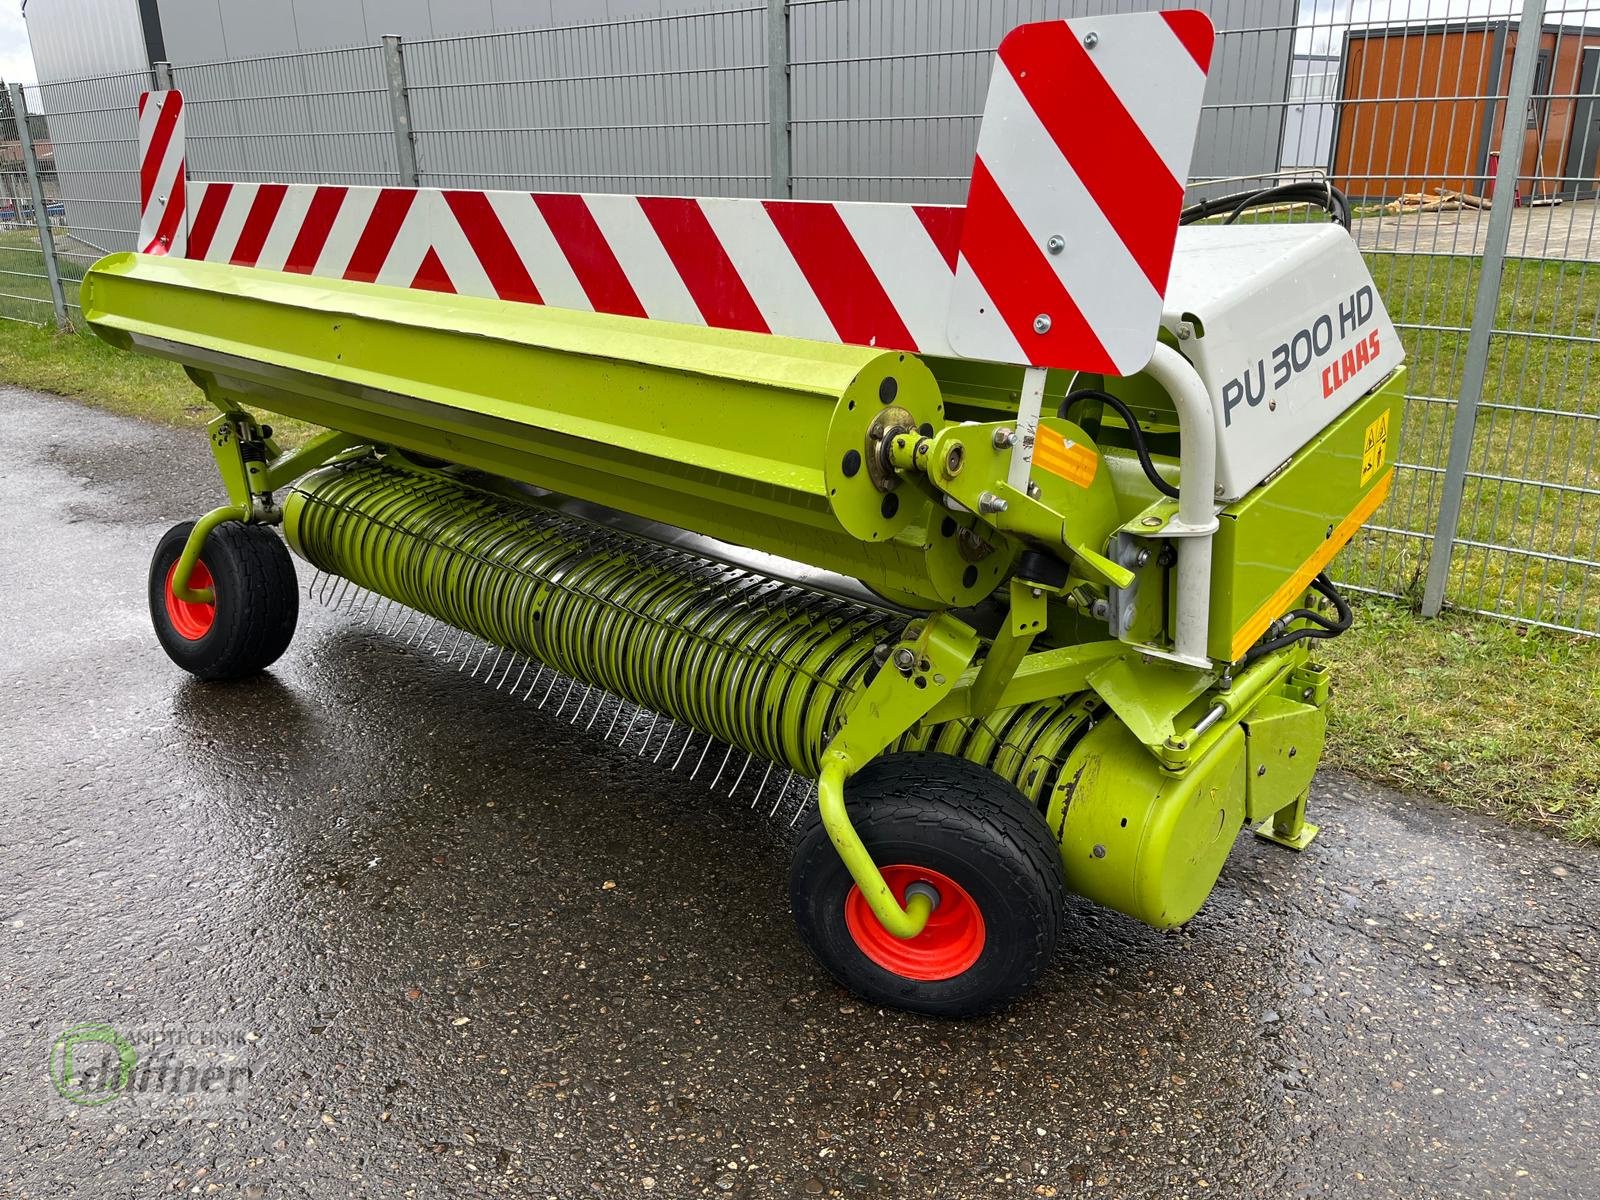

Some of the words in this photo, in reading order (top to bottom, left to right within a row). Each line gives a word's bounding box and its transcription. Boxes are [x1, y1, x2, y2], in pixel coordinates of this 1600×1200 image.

[1222, 359, 1266, 428] PU
[1271, 314, 1333, 390] 300
[1338, 284, 1374, 340] HD
[1321, 328, 1381, 399] CLAAS
